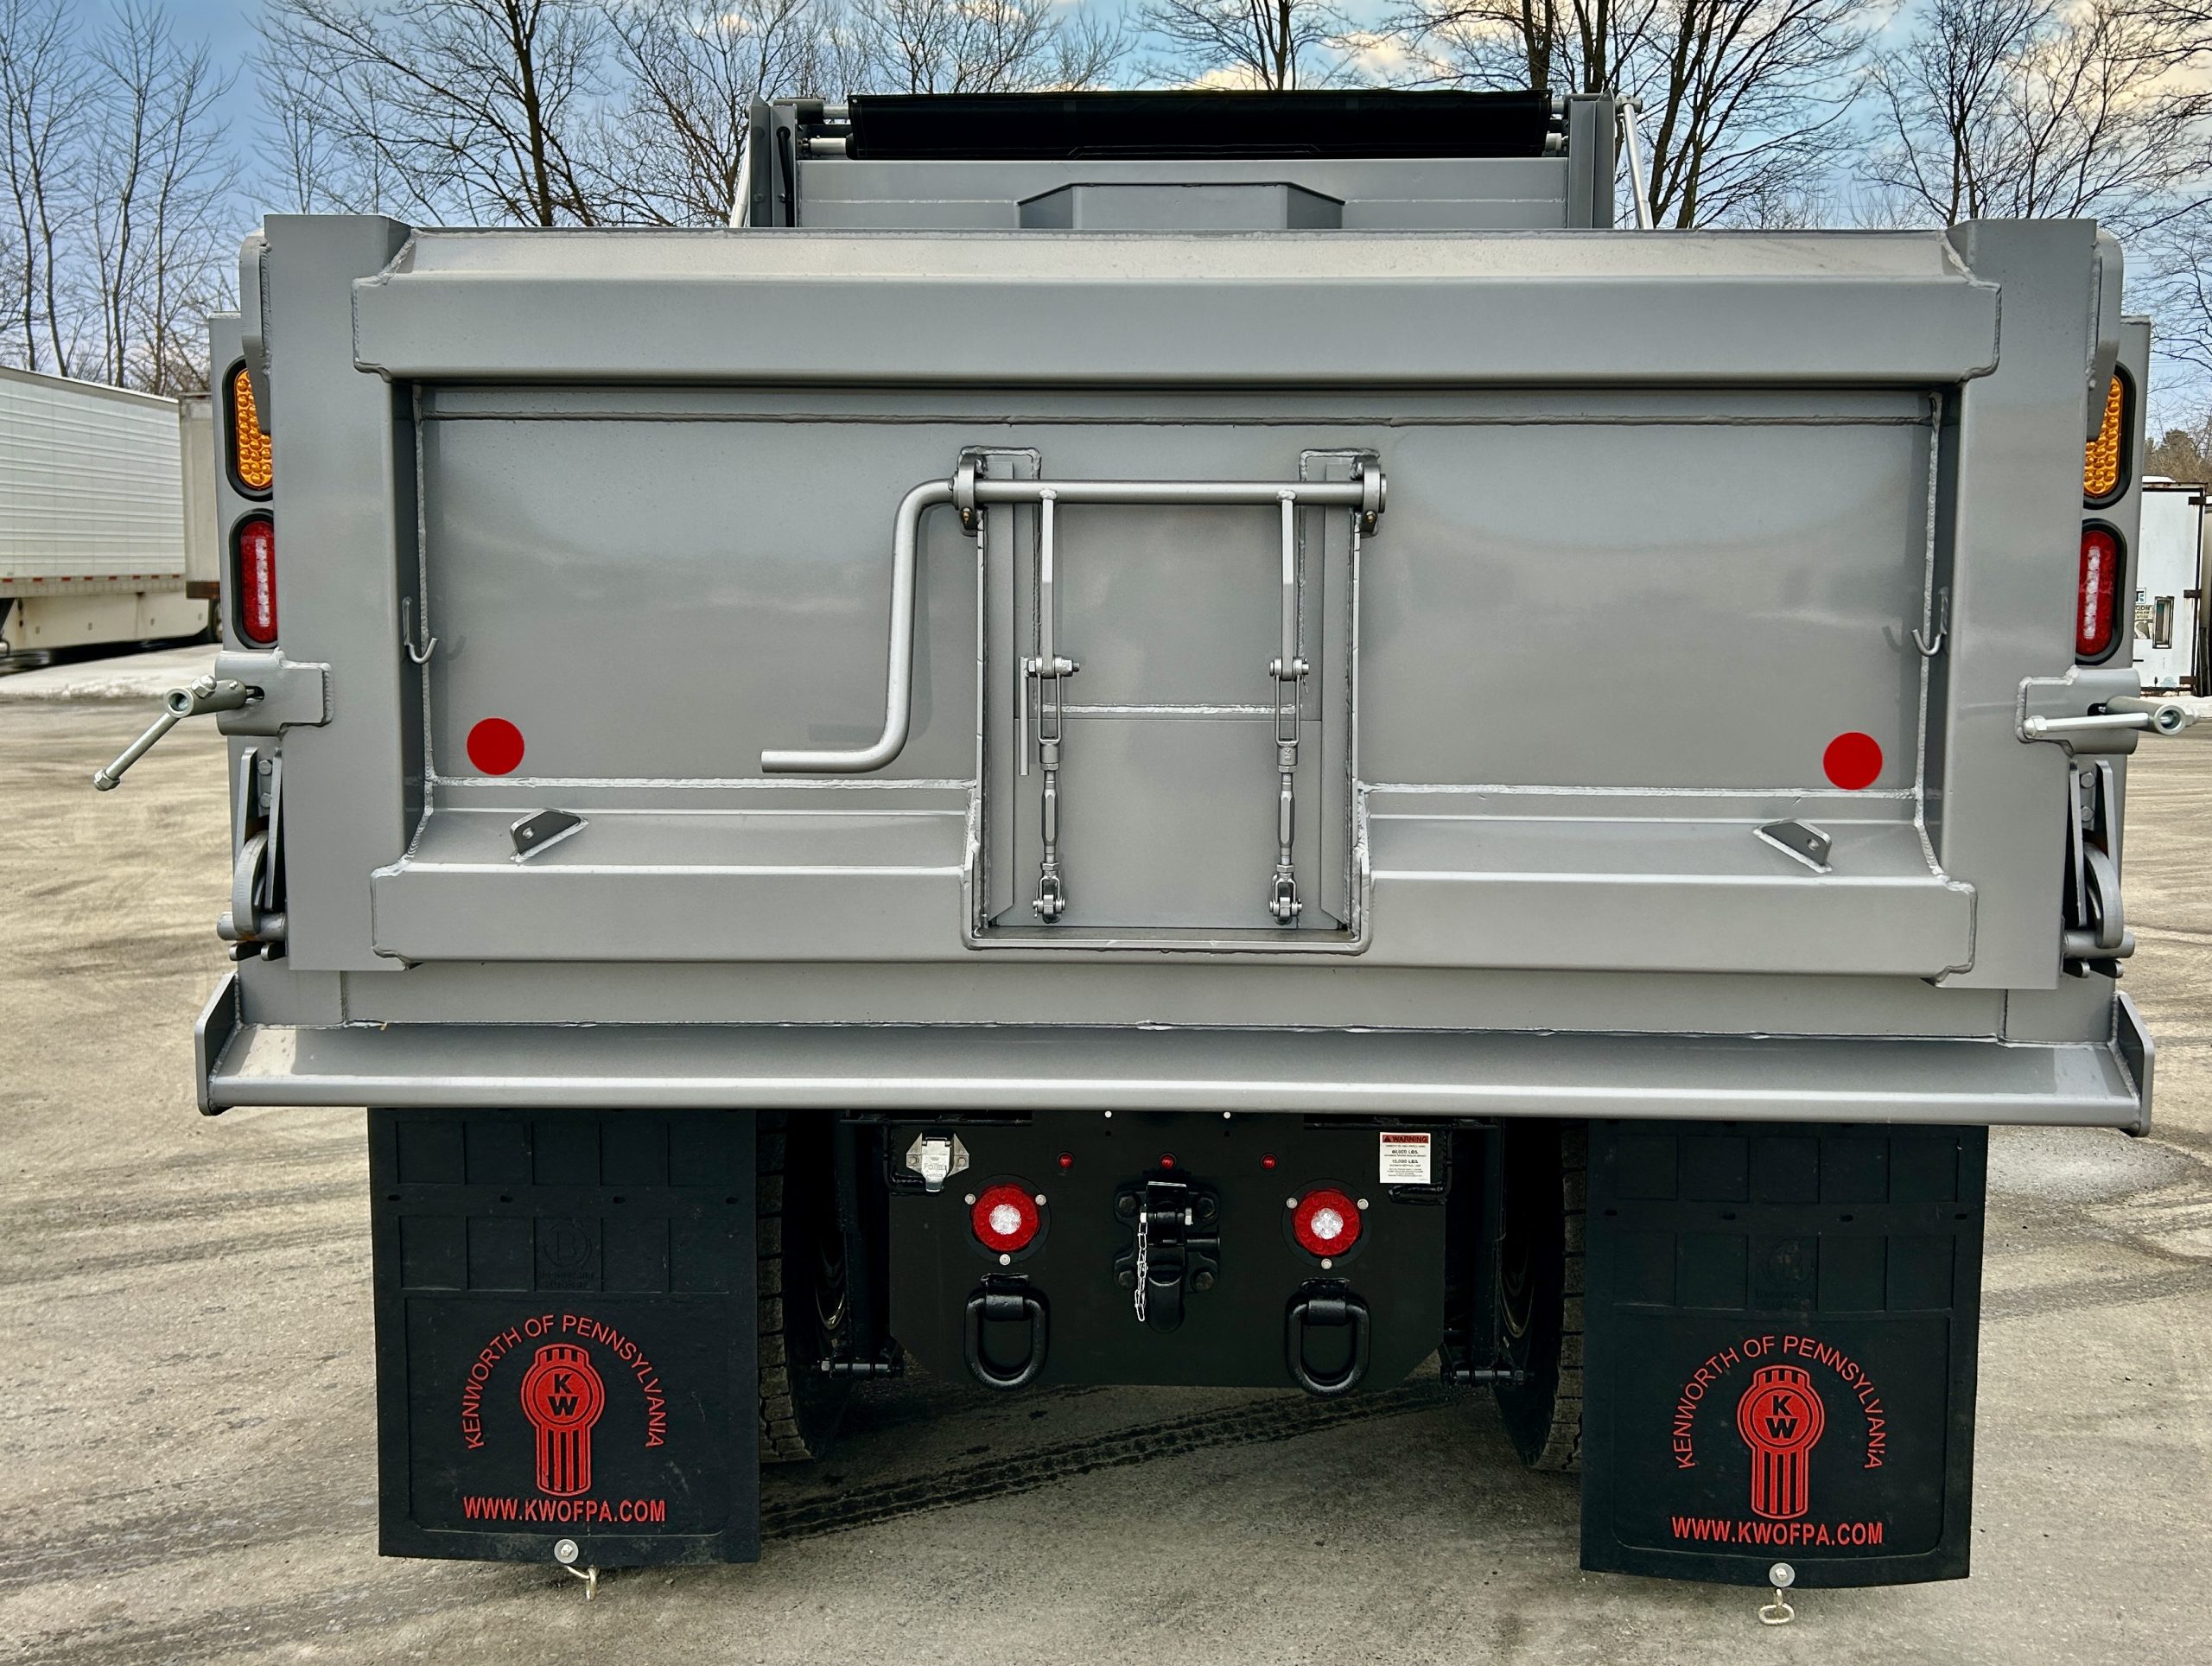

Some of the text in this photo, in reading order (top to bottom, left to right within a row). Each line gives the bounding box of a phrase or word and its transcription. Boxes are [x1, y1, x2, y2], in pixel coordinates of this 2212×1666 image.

[462, 1314, 667, 1449] KENWORTH OF PENNSYLVANIA
[553, 1373, 573, 1395] K
[547, 1396, 580, 1416] W
[1673, 1335, 1886, 1469] KENWORTH OF PENNSYLVANIA
[1772, 1395, 1793, 1416] K
[1765, 1418, 1798, 1439] W
[463, 1497, 666, 1522] WWW.KWOFPA.COM
[1671, 1516, 1883, 1546] WWW.KWOFPA.COM
